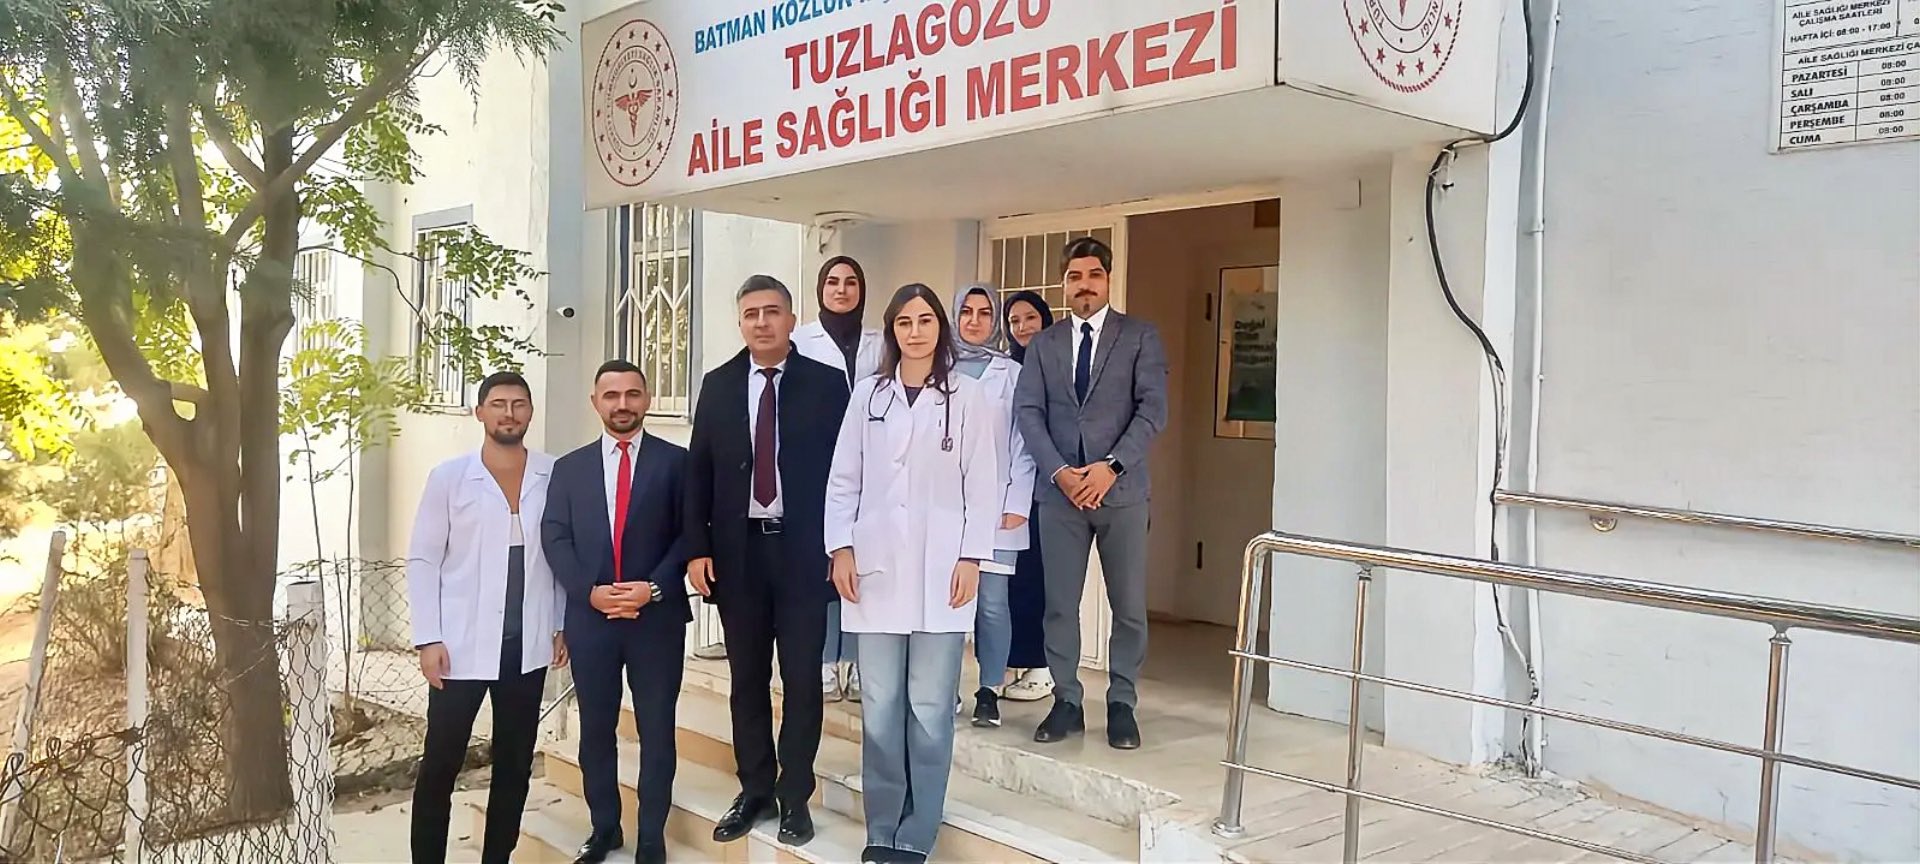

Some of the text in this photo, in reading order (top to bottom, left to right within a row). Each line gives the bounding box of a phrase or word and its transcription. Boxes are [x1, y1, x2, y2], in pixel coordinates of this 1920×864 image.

[1793, 10, 1812, 19] AİLE
[1799, 14, 1837, 27] ÇALIŞMA
[694, 10, 766, 54] BATMAN
[1790, 32, 1818, 43] HAFTA
[1836, 27, 1860, 37] 08:00
[1868, 22, 1891, 32] 17:00
[1798, 55, 1818, 64] AİLE
[1820, 49, 1859, 61] SAĞLIĞI
[1861, 42, 1904, 56] MERKEZİ
[1791, 66, 1848, 83] PAZARTESİ
[688, 0, 1237, 177] AİLE SAĞLIĞI MERKEZİ
[1790, 88, 1813, 98] SALI
[1790, 99, 1849, 116] ÇARŞAMBA
[1790, 115, 1845, 129] PERŞEMBE
[1789, 134, 1822, 145] CUMA
